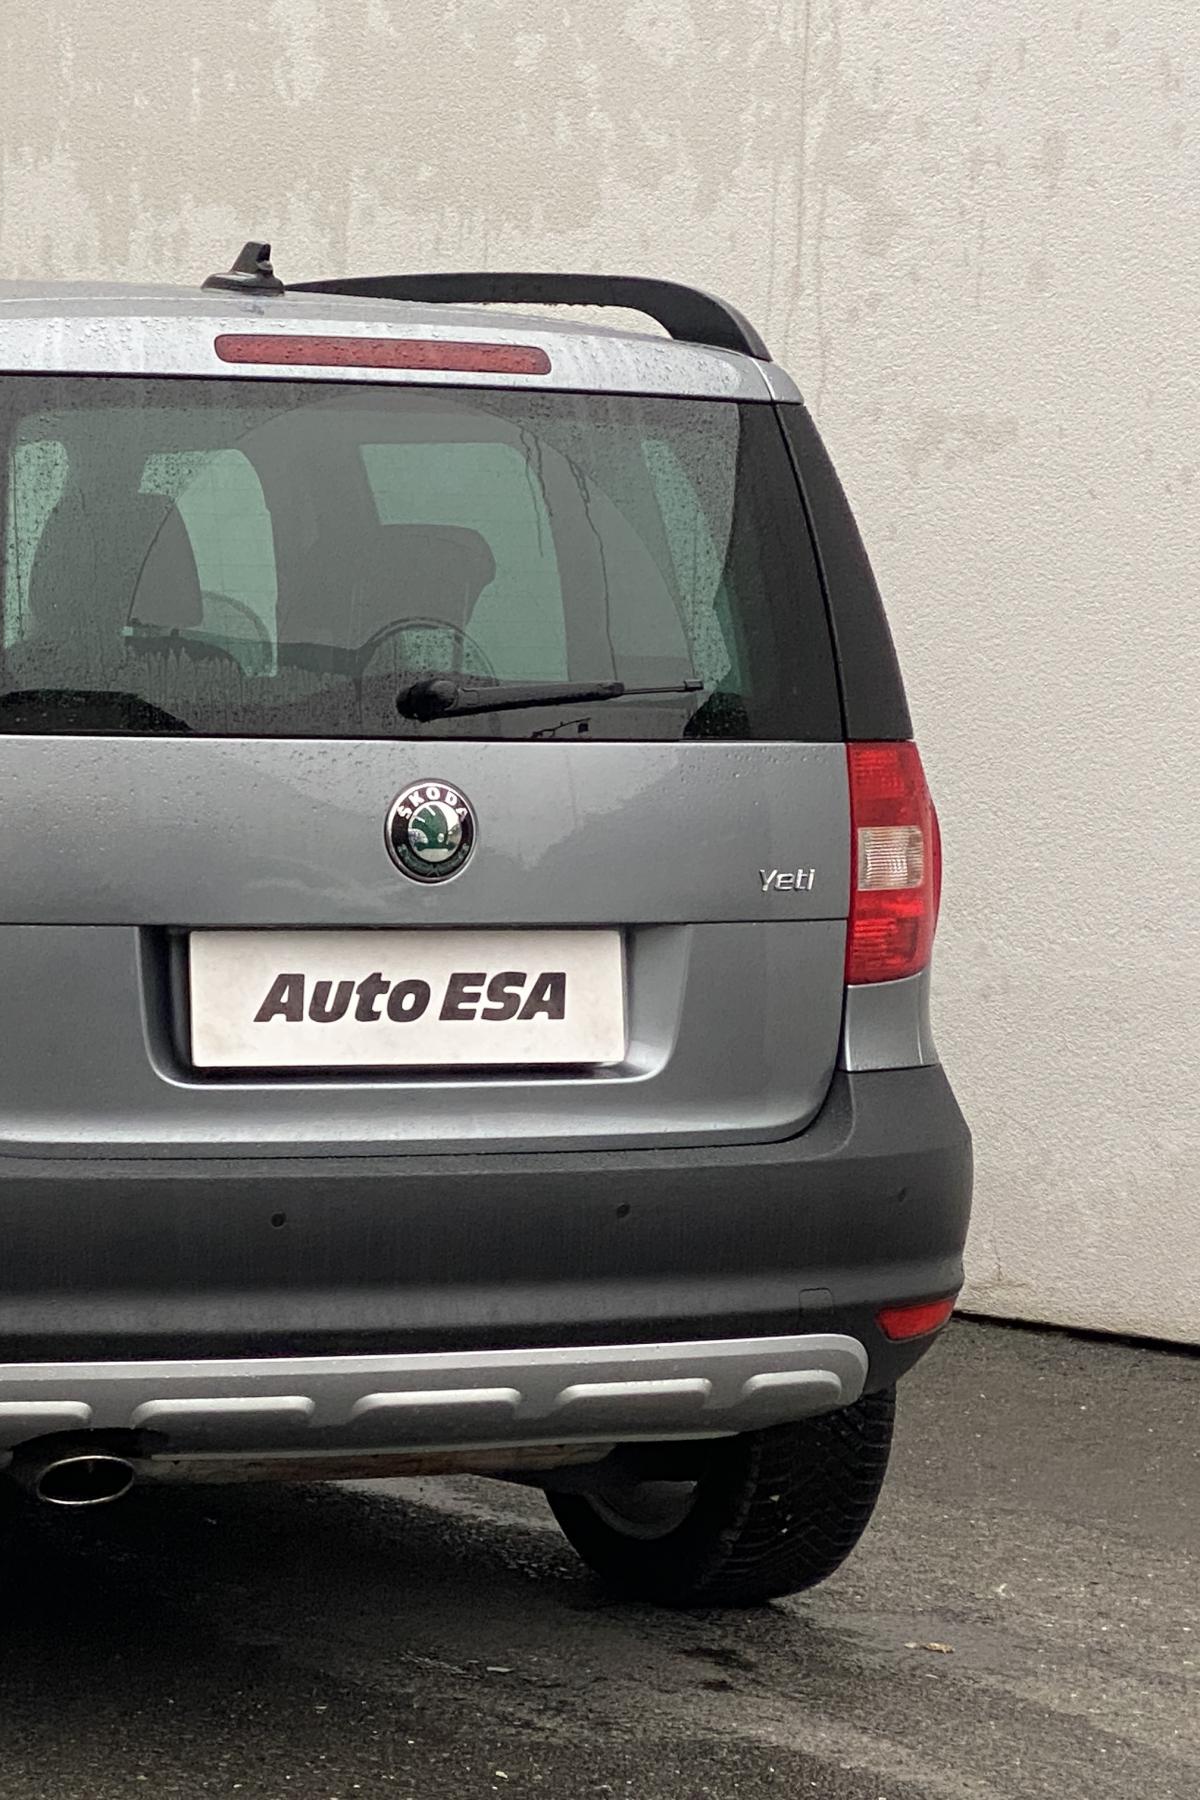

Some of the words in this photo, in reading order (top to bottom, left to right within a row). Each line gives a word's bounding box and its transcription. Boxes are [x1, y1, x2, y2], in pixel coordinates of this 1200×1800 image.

[759, 868, 816, 891] Yeti
[253, 972, 431, 1023] Auto
[439, 971, 567, 1021] ESA
